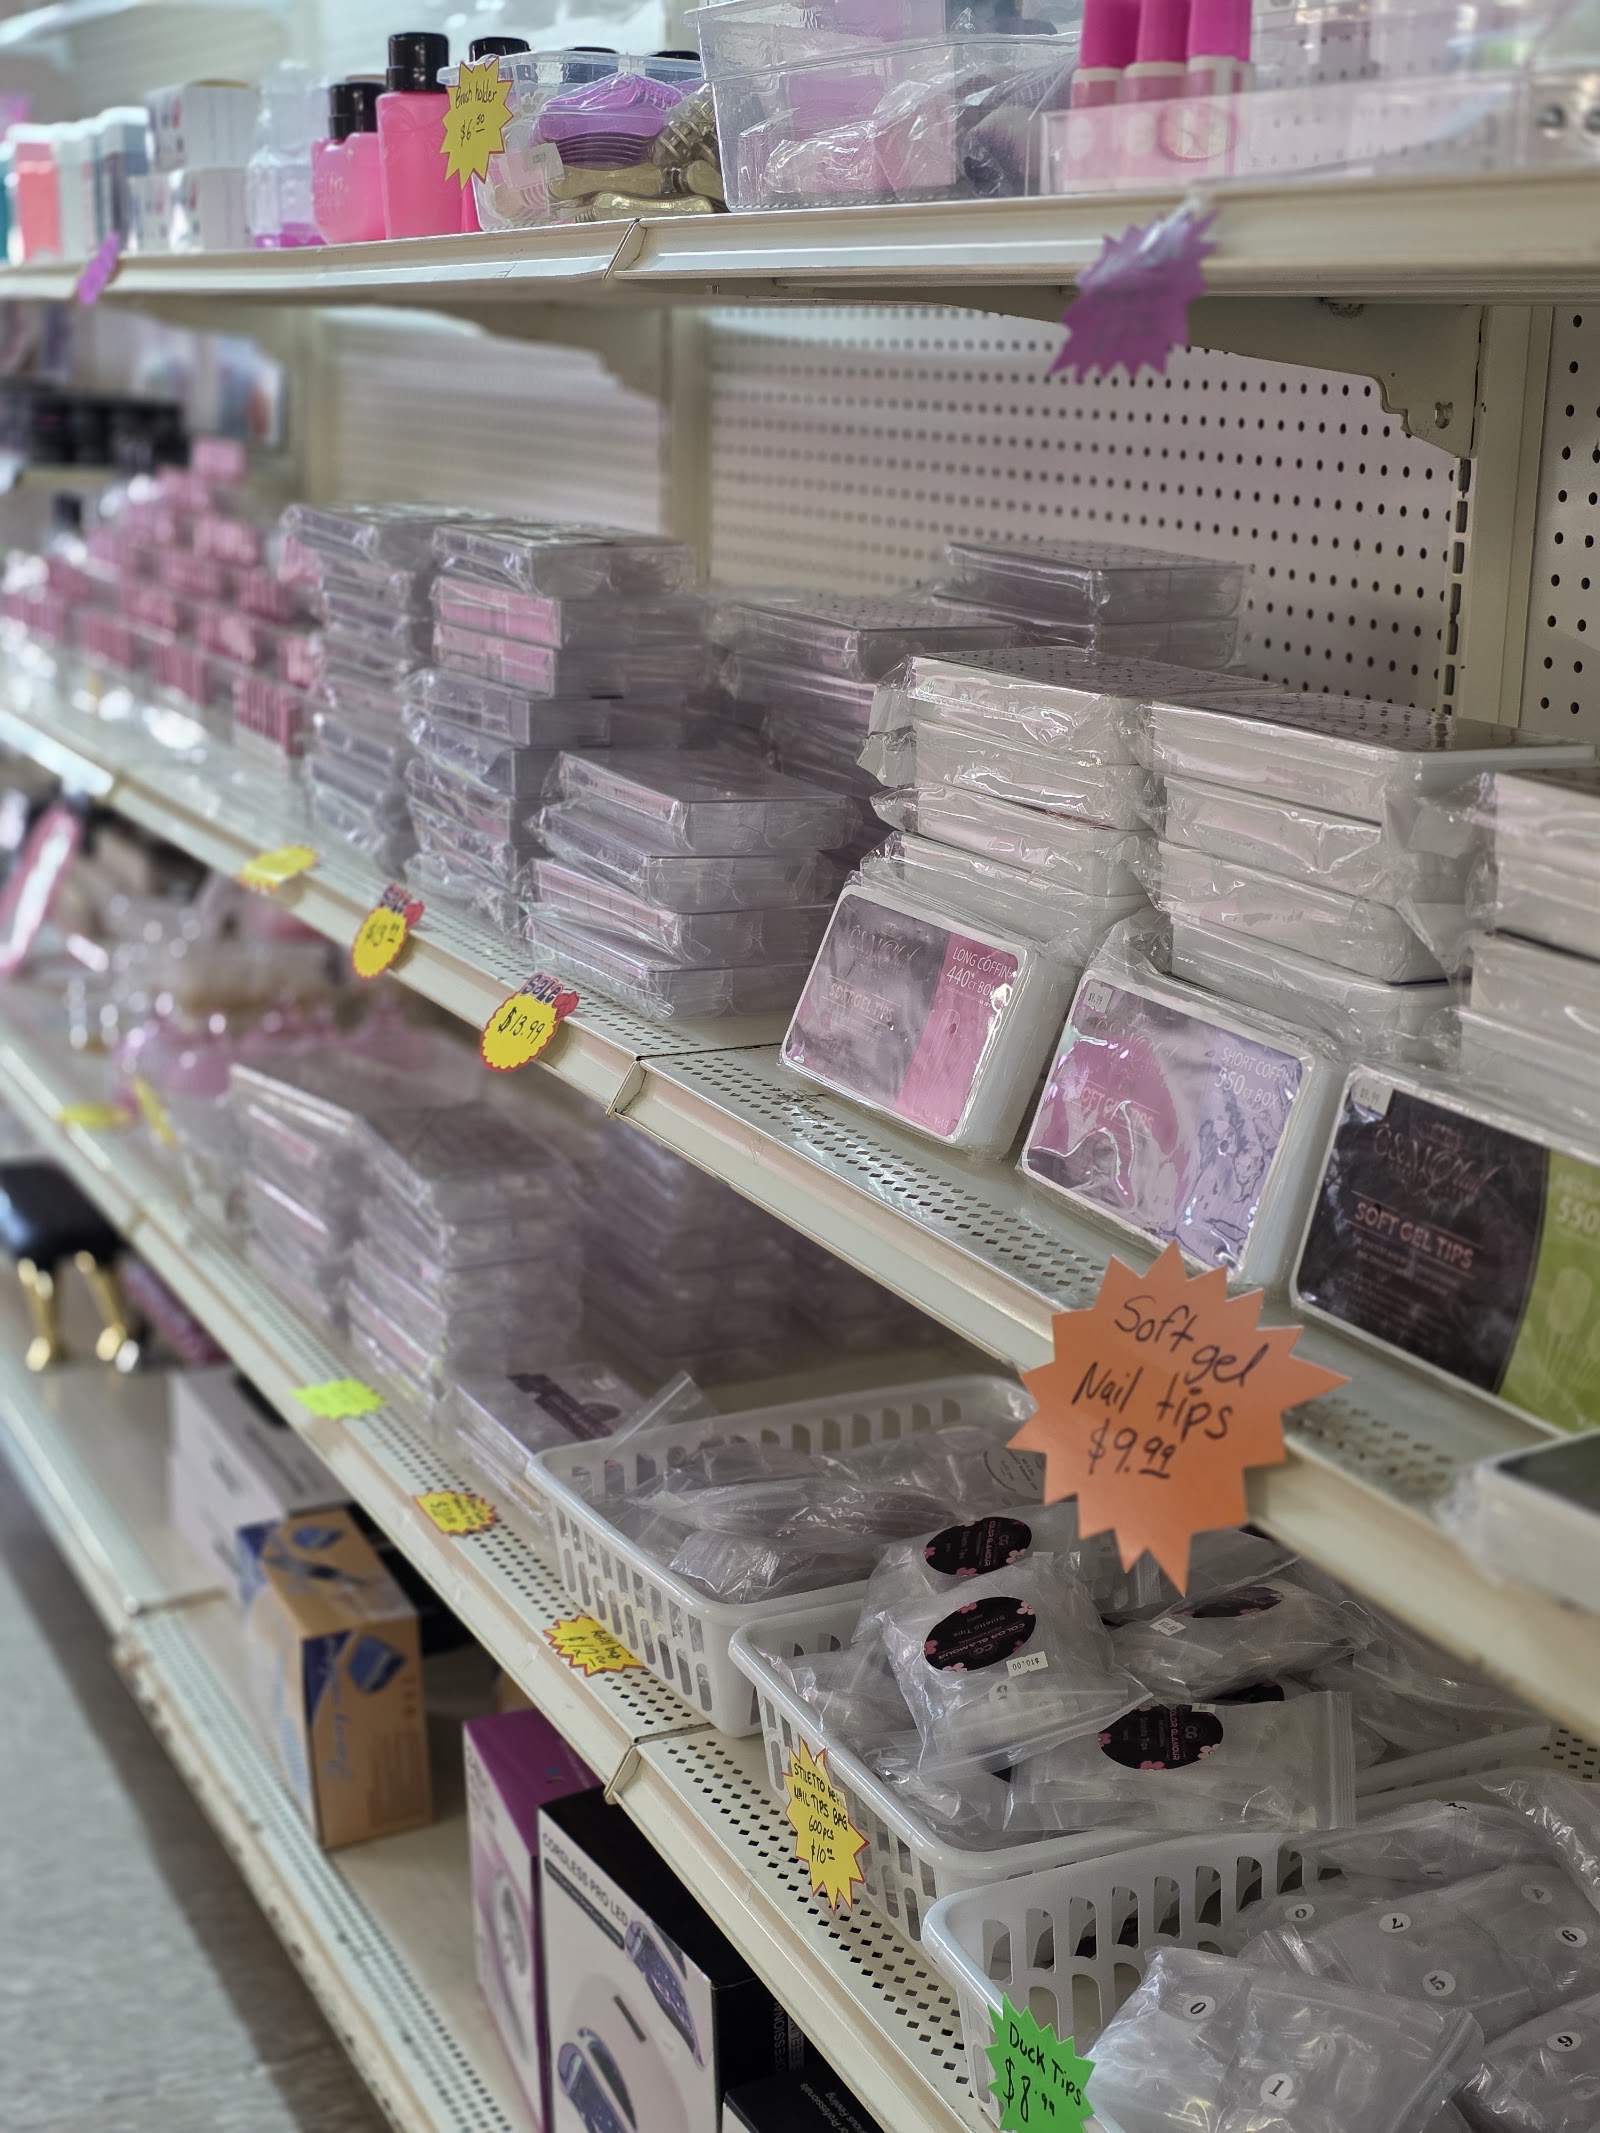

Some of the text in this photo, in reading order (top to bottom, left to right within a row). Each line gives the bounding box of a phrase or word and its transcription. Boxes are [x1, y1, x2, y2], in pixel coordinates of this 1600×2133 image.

[475, 79, 497, 104] holder
[952, 946, 1011, 980] LONG COFFIN
[976, 981, 998, 996] BO
[497, 1006, 546, 1045] $13.99
[871, 998, 895, 1024] TIPS
[1220, 1046, 1292, 1086] SHORT COFFIN
[1253, 1087, 1279, 1109] BOX
[1354, 1200, 1399, 1237] SOFT
[1399, 1220, 1432, 1253] GEL
[1435, 1236, 1475, 1271] TIPS
[1114, 1294, 1270, 1388] Soft gel
[1070, 1361, 1234, 1443] Nail tips
[1087, 1417, 1177, 1480] $9.99
[938, 1621, 1027, 1661] COLOR GLAMOUR
[1012, 1656, 1041, 1672] $10.00
[1170, 1728, 1181, 1761] GLAMOUR
[793, 1762, 826, 1793] STILETTO
[811, 1793, 830, 1818] TIPS
[832, 1809, 849, 1832] BAG
[822, 1826, 835, 1840] pcs
[588, 1876, 610, 1907] PRO
[609, 1900, 630, 1927] LED
[1391, 1917, 1404, 1930] 7
[1428, 1974, 1446, 1991] 5
[1008, 2021, 1082, 2107] Duck Tips
[825, 2090, 850, 2117] Feeling
[1267, 2078, 1286, 2097] 1
